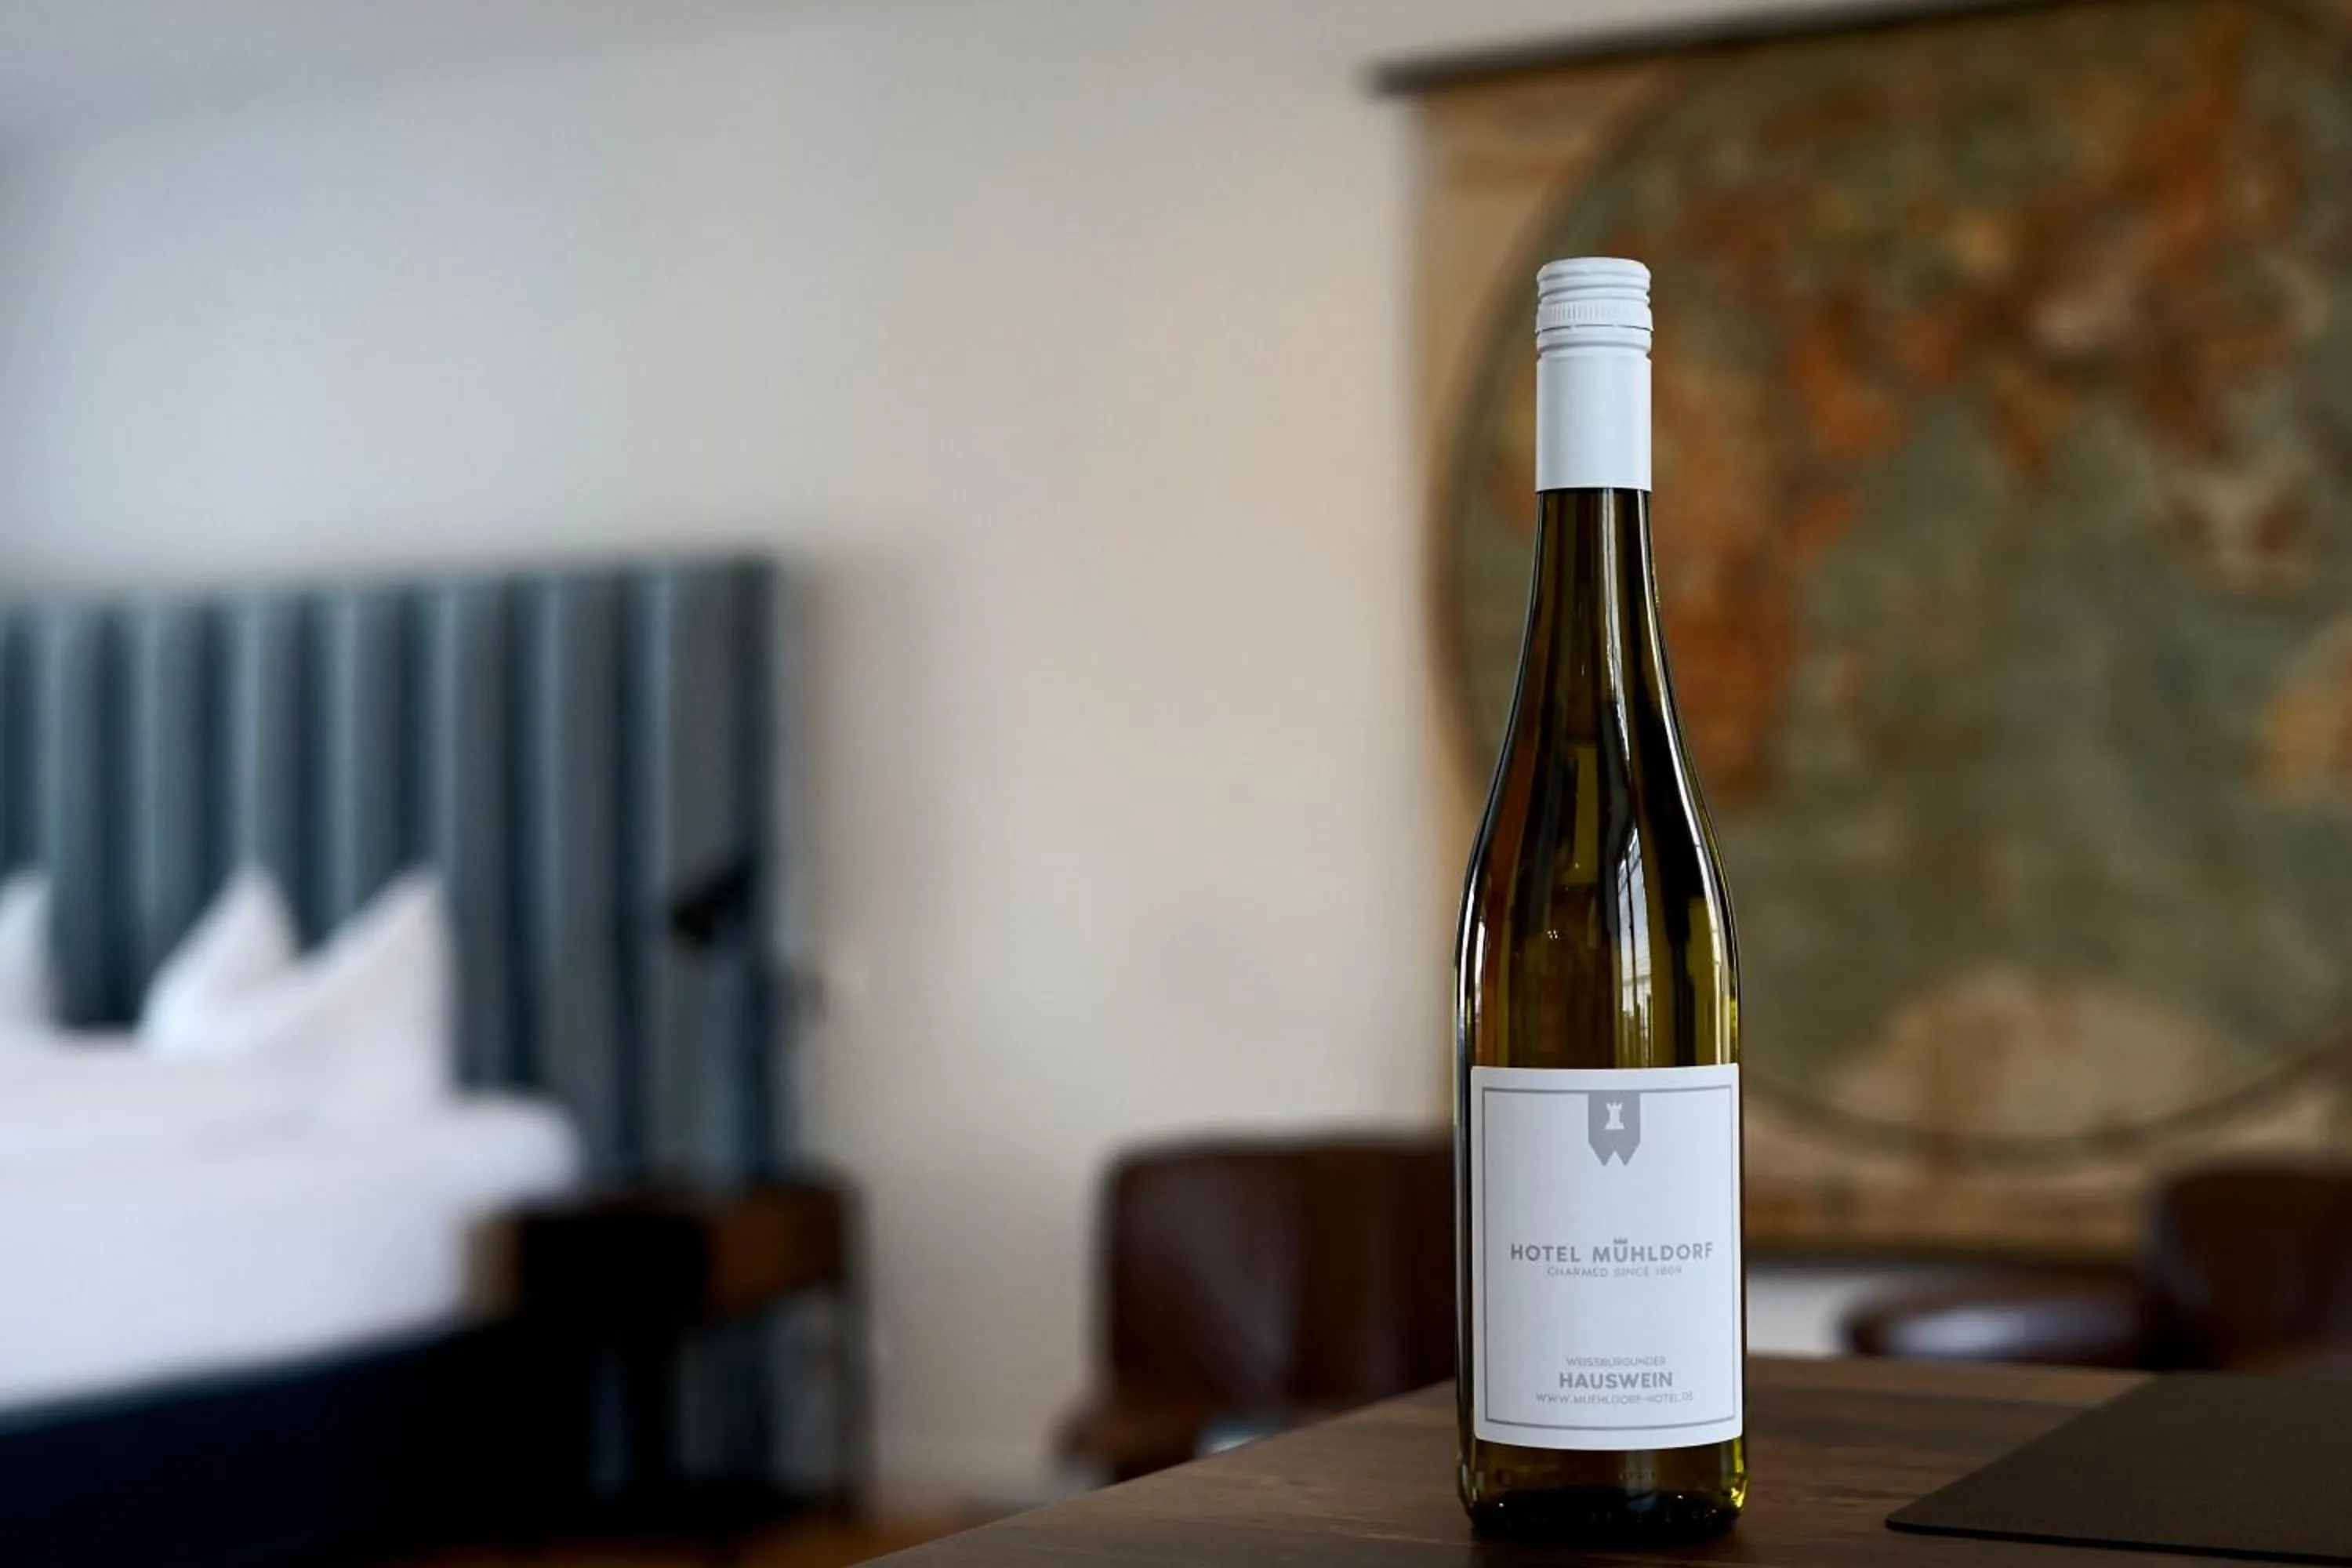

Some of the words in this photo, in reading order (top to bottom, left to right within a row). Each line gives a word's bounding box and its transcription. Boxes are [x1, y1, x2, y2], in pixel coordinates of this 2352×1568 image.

[1510, 1243, 1581, 1262] HOTEL
[1592, 1237, 1713, 1263] MÜHLDORF
[1547, 1266, 1607, 1278] CHARMED
[1613, 1265, 1649, 1278] SINCE
[1566, 1356, 1666, 1367] WEISSBURGUNDER
[1559, 1371, 1673, 1389] HAUSWEIN
